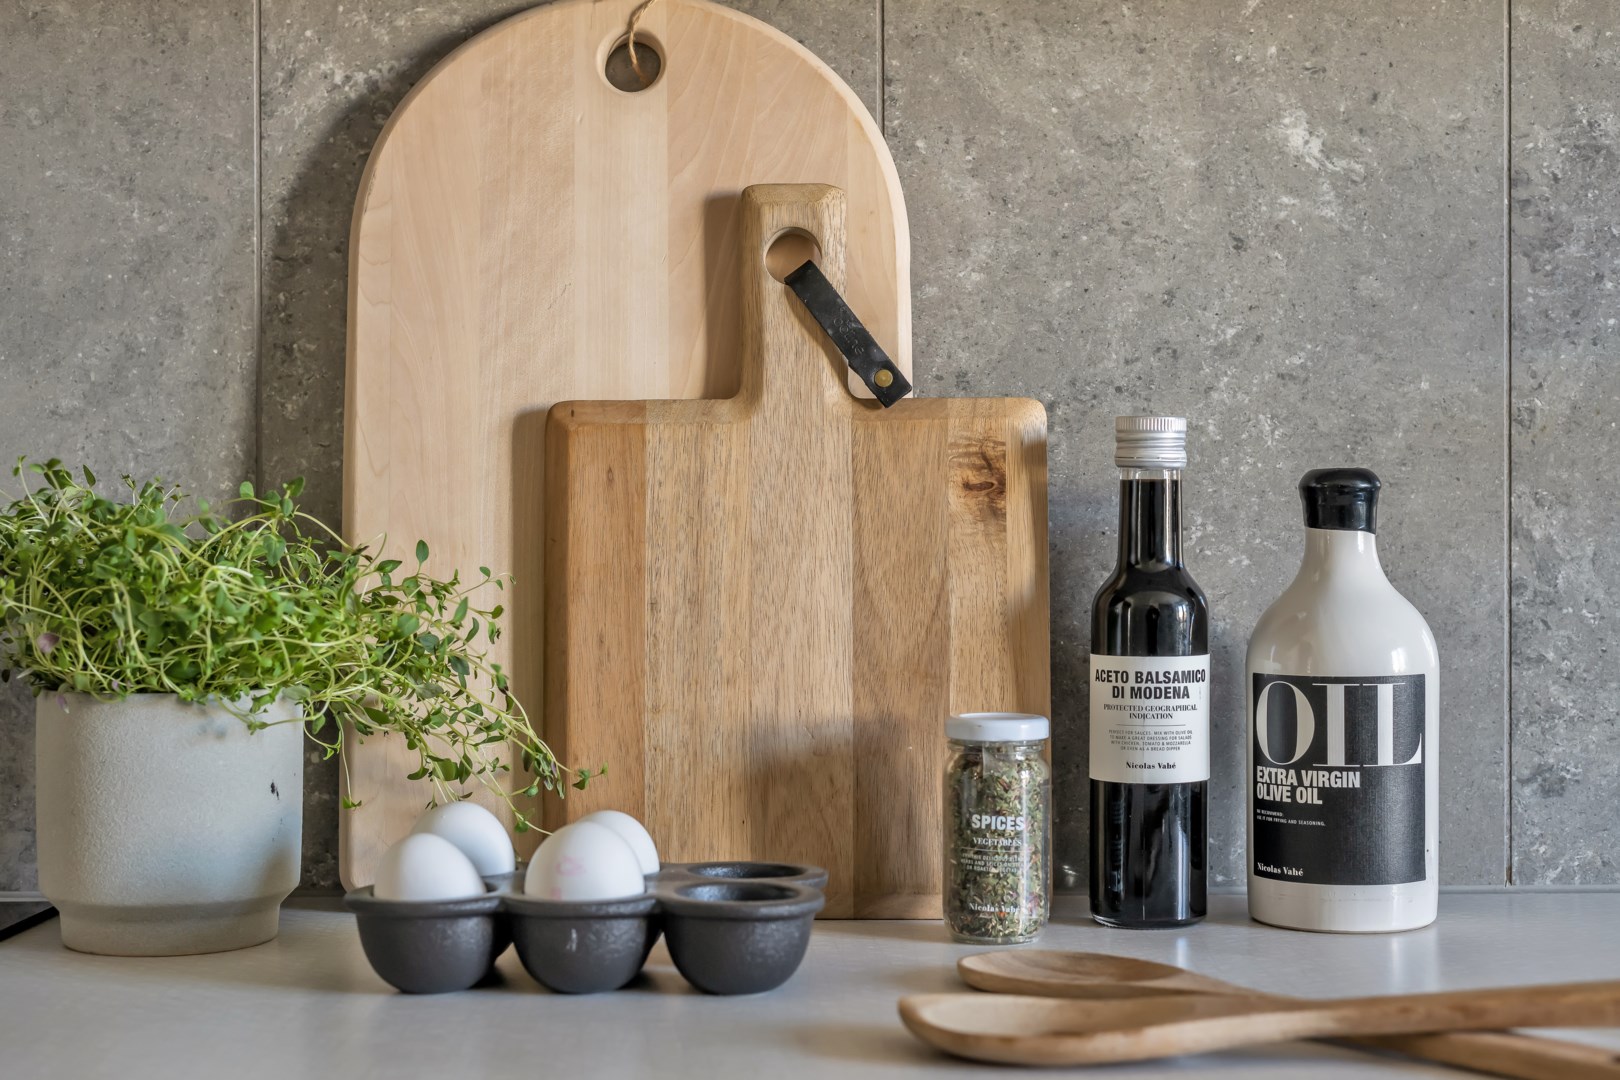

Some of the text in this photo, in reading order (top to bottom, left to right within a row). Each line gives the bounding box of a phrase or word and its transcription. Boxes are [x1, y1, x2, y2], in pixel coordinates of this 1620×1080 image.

[1095, 669, 1206, 684] ACETO BALSAMICO
[1112, 686, 1190, 700] DI MODENA
[1256, 680, 1422, 767] OIL
[1257, 766, 1360, 788] EXTRA VIRGIN
[1257, 783, 1323, 804] OLIVE OIL
[972, 814, 1024, 830] SPICES
[1258, 862, 1304, 876] Nicolas Vahé
[969, 903, 998, 912] Nicolas
